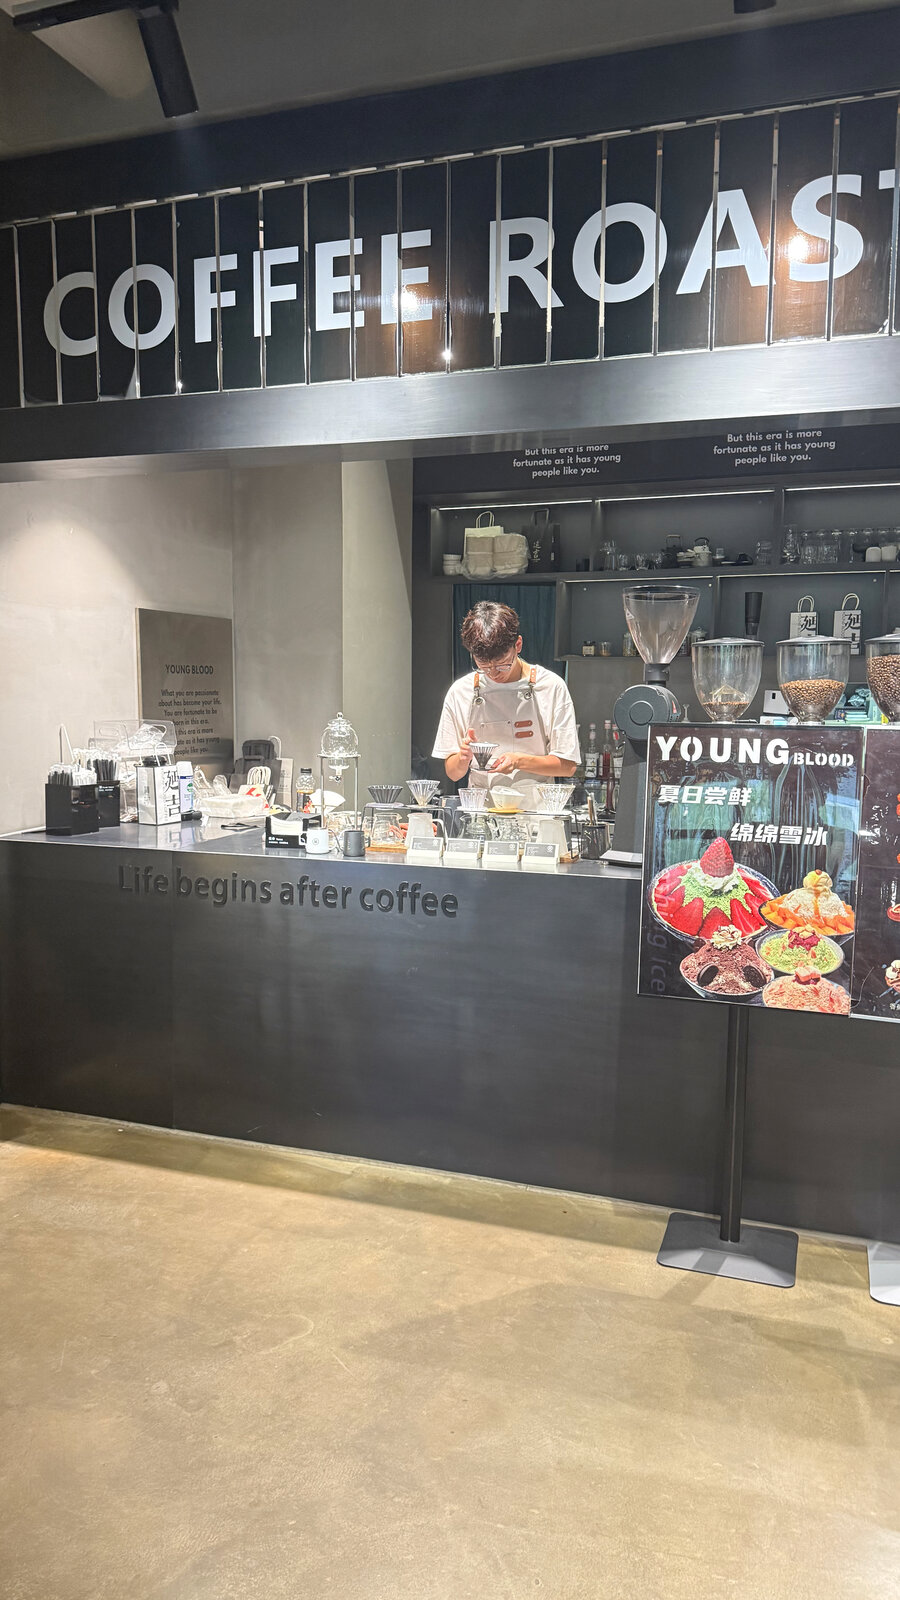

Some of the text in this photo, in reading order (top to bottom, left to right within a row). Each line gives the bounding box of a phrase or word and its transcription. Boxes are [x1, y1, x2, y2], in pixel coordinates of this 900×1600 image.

[44, 229, 433, 357] COFFEE
[727, 434, 743, 442] But
[746, 432, 762, 442] this
[786, 430, 793, 438] is
[796, 430, 822, 438] more
[542, 447, 556, 455] this
[559, 446, 574, 454] era
[586, 444, 609, 452] more
[713, 441, 836, 454] fortunate as it has young
[512, 459, 552, 468] fortunate
[567, 456, 574, 464] it
[576, 455, 591, 463] has
[594, 454, 622, 464] young
[734, 453, 812, 467] people like you.
[532, 466, 600, 479] people like you.
[166, 664, 214, 674] YOUNG BLOOD
[184, 708, 204, 716] fortunate
[206, 736, 220, 744] young
[656, 736, 854, 766] YOUNG BLOOD
[658, 784, 752, 806] 夏日尝鲜
[730, 822, 828, 846] 绵绵雪冰
[118, 865, 458, 918] Life begins after coffee
